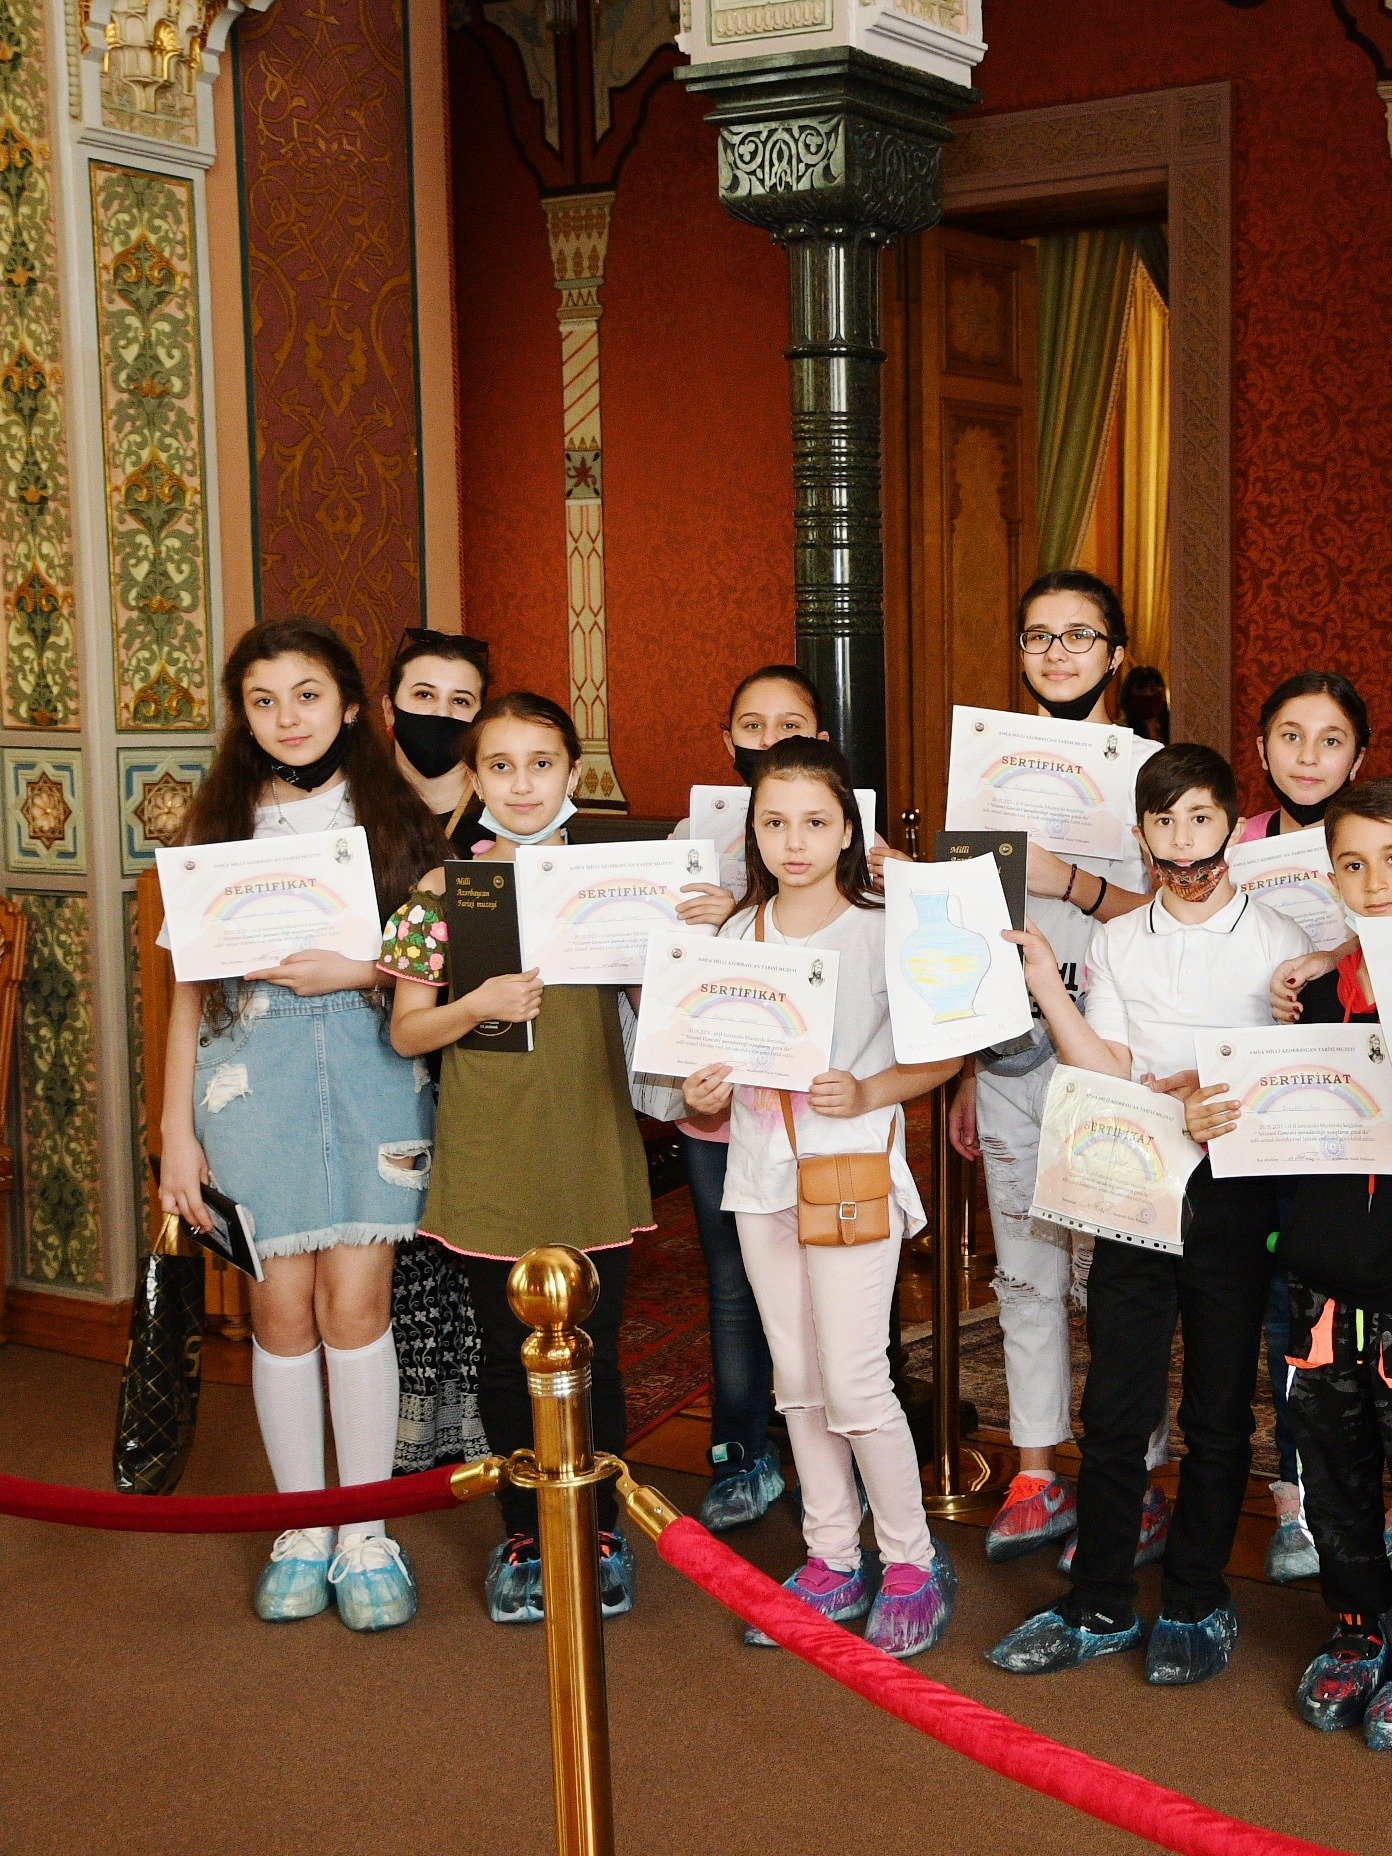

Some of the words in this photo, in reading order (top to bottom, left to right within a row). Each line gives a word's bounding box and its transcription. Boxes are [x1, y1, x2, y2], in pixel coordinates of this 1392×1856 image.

[1001, 755, 1083, 775] SERTİFİKAT
[949, 845, 970, 854] Milli
[225, 876, 317, 896] SERTİFİKAT
[455, 877, 471, 886] Milli
[1240, 869, 1319, 893] SERTİFİKAT
[578, 885, 667, 899] SERTİFİKAT
[700, 983, 787, 1003] SERTİFİKAT
[1260, 1071, 1351, 1086] SERTİFİKAT
